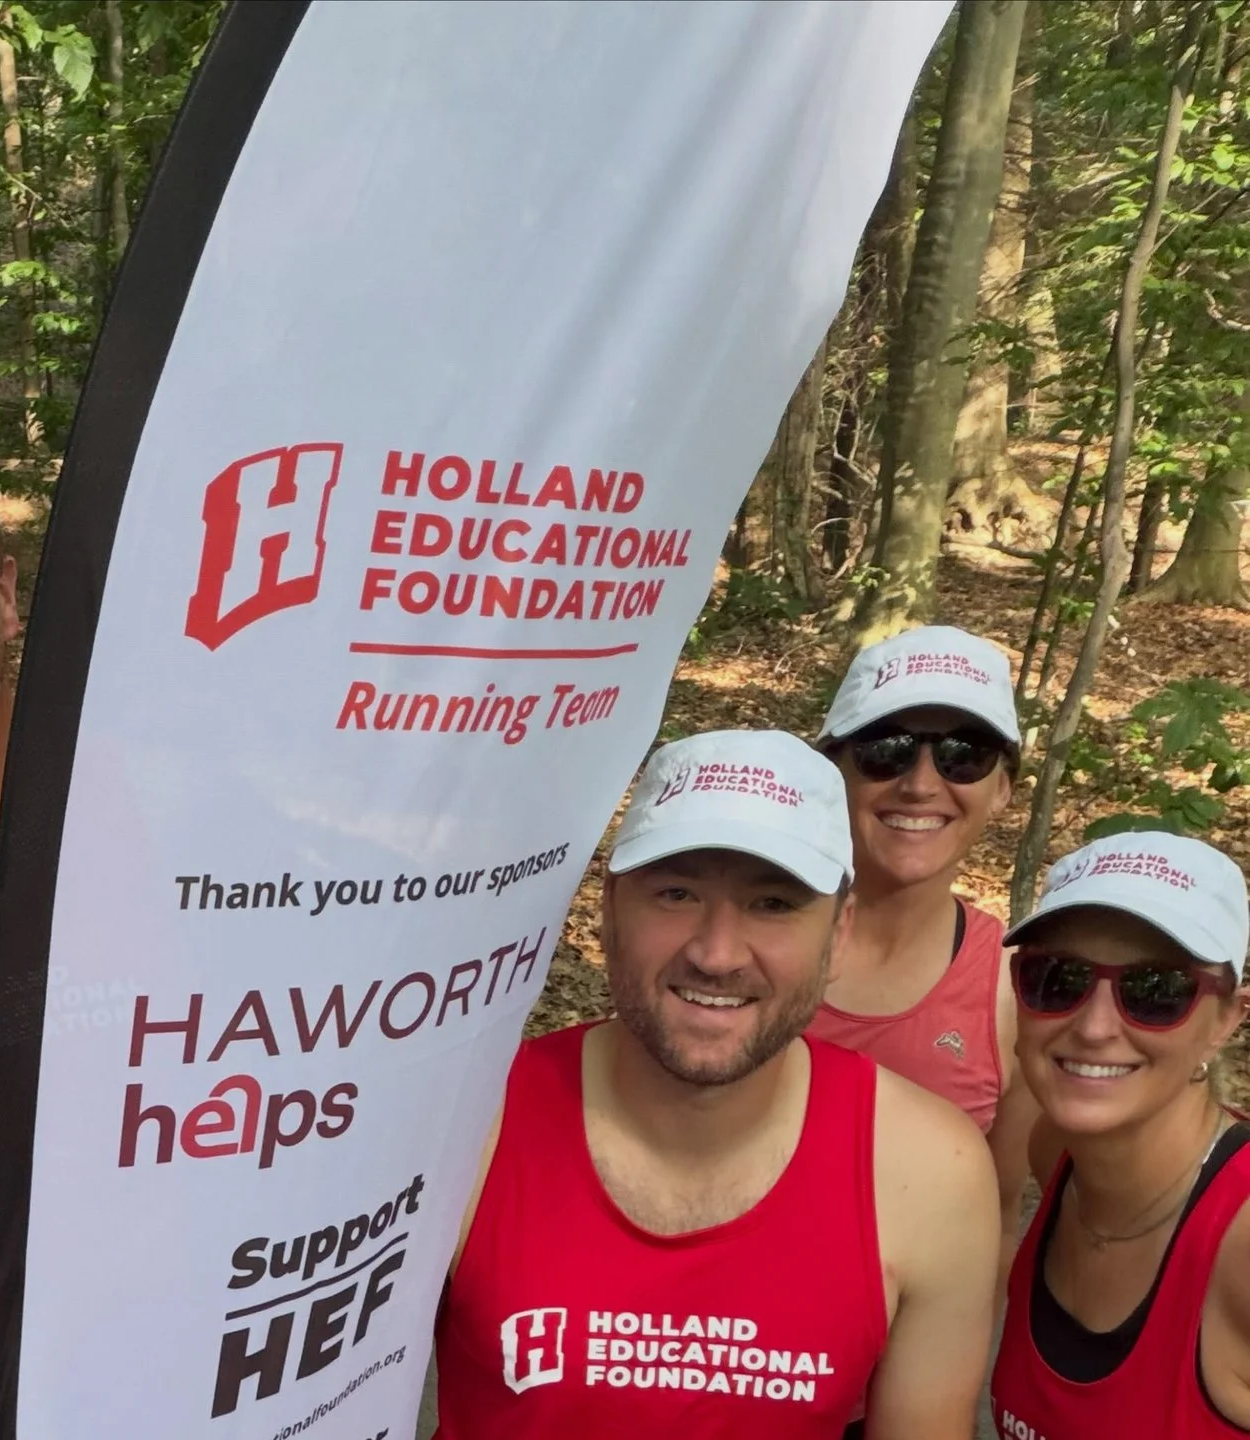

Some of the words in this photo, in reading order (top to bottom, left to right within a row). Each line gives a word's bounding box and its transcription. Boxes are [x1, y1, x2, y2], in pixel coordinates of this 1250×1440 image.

[381, 450, 644, 514] HOLLAND
[370, 510, 692, 569] EDUCATIONAL
[359, 568, 665, 622] FOUNDATION
[907, 653, 969, 665] HOLLAND
[336, 681, 541, 746] Running
[545, 684, 620, 730] Team
[691, 784, 799, 808] FOUNDATION
[694, 774, 805, 803] EDUCATIONAL
[698, 763, 775, 780] HOLLAND
[175, 873, 305, 911] Thank
[309, 879, 383, 916] you
[394, 873, 427, 902] to
[434, 868, 486, 899] our
[486, 841, 570, 897] sponsors
[1096, 852, 1169, 865] HOLLAND
[127, 926, 547, 1068] HAWORTH
[118, 1074, 359, 1170] helps
[226, 1173, 425, 1289] Support
[211, 1249, 407, 1419] HEF
[588, 1311, 758, 1342] HOLLAND
[585, 1366, 817, 1402] FOUNDATION
[586, 1338, 835, 1376] EDUCATIONAL
